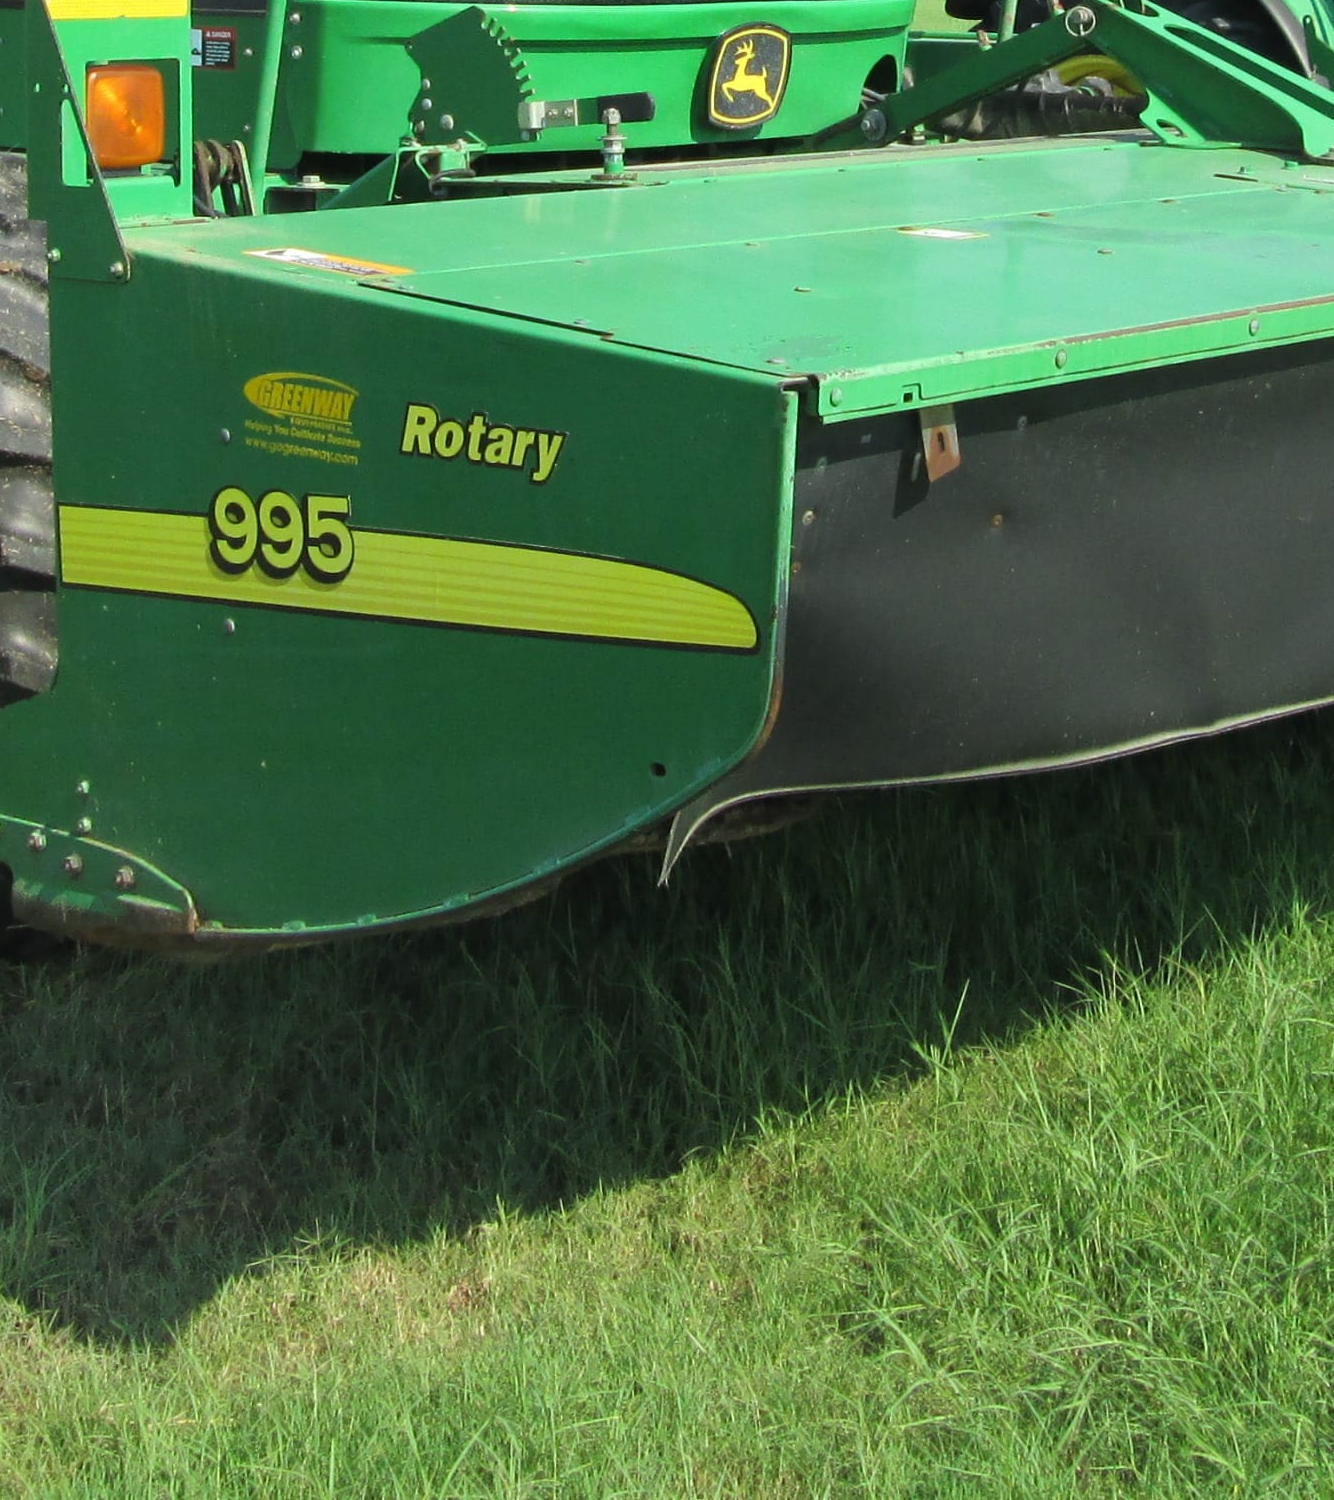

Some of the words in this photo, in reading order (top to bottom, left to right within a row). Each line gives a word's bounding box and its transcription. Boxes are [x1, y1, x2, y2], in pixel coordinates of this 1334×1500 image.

[257, 379, 356, 420] GREENWAY
[400, 403, 565, 483] Rotary
[211, 485, 355, 579] 995
